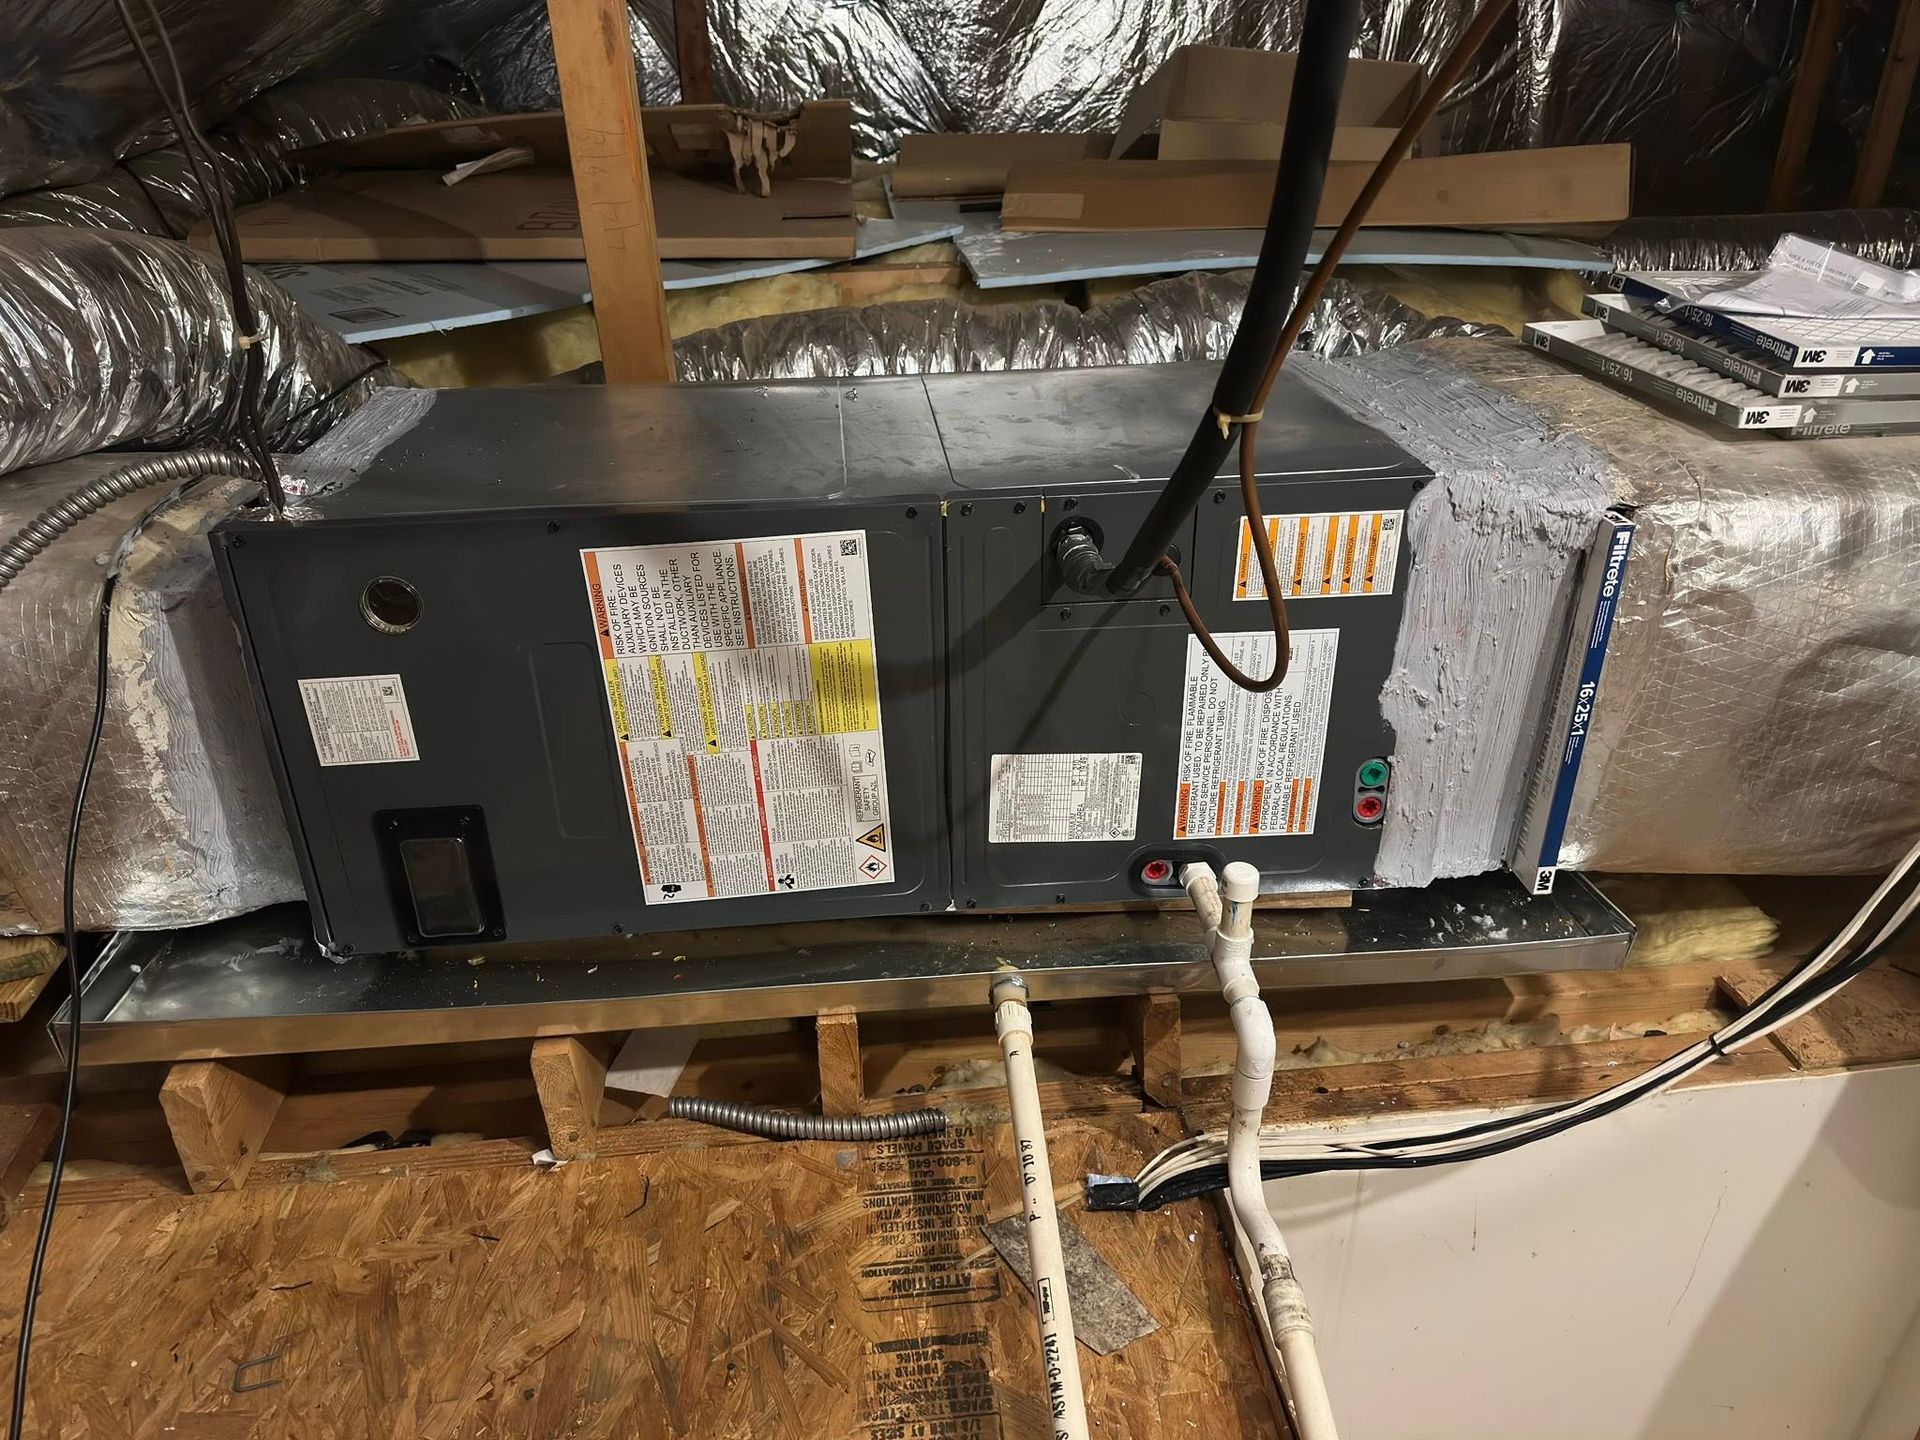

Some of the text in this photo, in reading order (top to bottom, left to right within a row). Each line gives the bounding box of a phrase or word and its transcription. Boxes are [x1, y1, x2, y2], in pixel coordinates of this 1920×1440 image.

[1534, 333, 1549, 349] 3M
[1755, 334, 1793, 361] Filtrete
[1801, 350, 1827, 363] 3M
[1723, 357, 1762, 386] Filtrete
[1784, 379, 1811, 393] 3M
[1675, 388, 1718, 416] Filtrete
[1745, 411, 1770, 425] 3M
[1239, 552, 1248, 578] WARNING
[1343, 536, 1355, 574] ADVERTENCIA
[1602, 531, 1631, 598] Filtrete
[626, 585, 638, 598] BE
[667, 558, 683, 592] OTHER
[711, 548, 728, 603] APPLIANCE.
[590, 583, 608, 628] WARNING
[606, 595, 619, 616] FIRE
[611, 563, 637, 654] AUXILIARY DEVICES
[629, 599, 642, 620] MAY
[634, 563, 658, 652] IGNITION SOURCES
[658, 568, 680, 651] INSTALLED IN THE
[681, 574, 702, 649] THAN AUXILIARY
[689, 551, 713, 648] DEVICES LISTED FOR
[705, 582, 723, 647] USE WITH THE
[723, 554, 745, 646] SEE INSTRUCTIONS.
[610, 618, 622, 631] OF
[649, 586, 670, 651] SHALL NOT BE
[673, 593, 692, 650] DUCTWORK,
[719, 604, 734, 647] SPECIFIC
[613, 633, 626, 655] RISK
[633, 621, 648, 653] WHICH
[1199, 658, 1210, 682] ONLY
[1186, 675, 1198, 726] FLAMMABLE
[1196, 683, 1208, 726] REPAIRED
[1261, 691, 1273, 722] DISPOS
[1272, 687, 1283, 709] WITH
[1570, 681, 1596, 736] 16x25x1
[1193, 740, 1203, 752] TO
[1194, 727, 1204, 739] BE
[1266, 710, 1281, 768] ACCORDANCE
[1183, 750, 1192, 762] OF
[1191, 754, 1202, 778] USED.
[1197, 677, 1218, 833] TRAINED SERVICE PERSONNEL. DO NOT
[1206, 700, 1227, 833] PUNCTURE REFRIGERANT TUBING.
[1255, 759, 1265, 778] RISK
[1257, 747, 1267, 758] OF
[1268, 694, 1293, 830] FEDERAL OR LOCAL REGULATIONS.
[1278, 699, 1302, 829] FLAMMABLE REFRIGERANT USED.
[1181, 763, 1191, 782] RISK
[1265, 769, 1274, 777] IN
[853, 776, 865, 821] REFRIGERANT
[861, 786, 871, 811] SAFETY
[869, 779, 879, 816] GROUP A2L
[1177, 788, 1189, 826] WARNING
[1187, 779, 1200, 833] REFRIGERANT
[1250, 785, 1262, 823] WARNING
[1535, 869, 1554, 892] 3M
